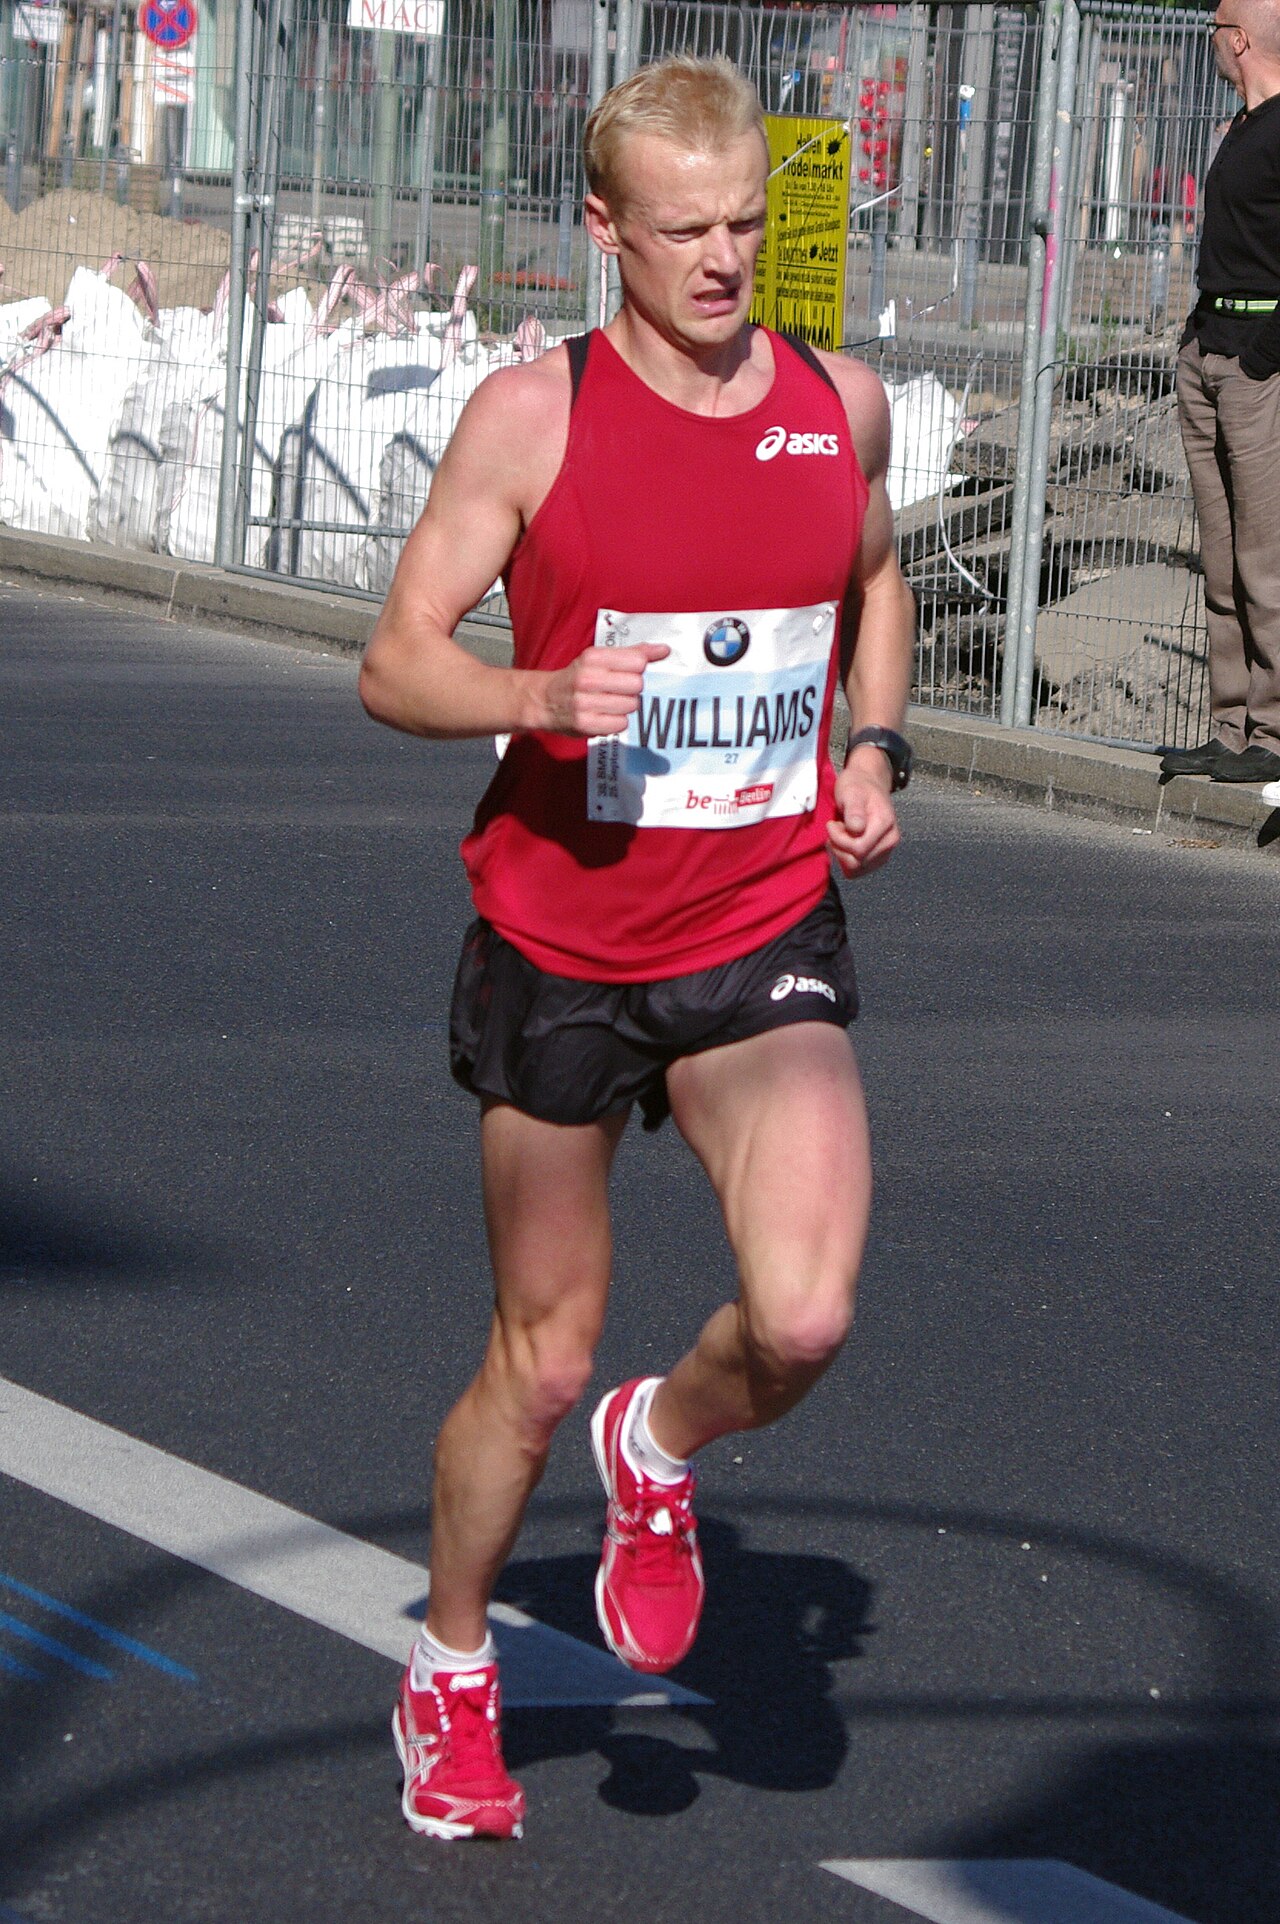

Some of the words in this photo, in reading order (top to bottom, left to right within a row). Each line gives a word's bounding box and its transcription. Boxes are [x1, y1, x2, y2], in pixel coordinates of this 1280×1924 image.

[361, 0, 435, 29] MAC
[819, 241, 838, 263] Jetzt
[786, 433, 839, 456] asics
[637, 685, 816, 749] WILLIAMS
[724, 753, 739, 764] 27
[686, 790, 712, 809] be
